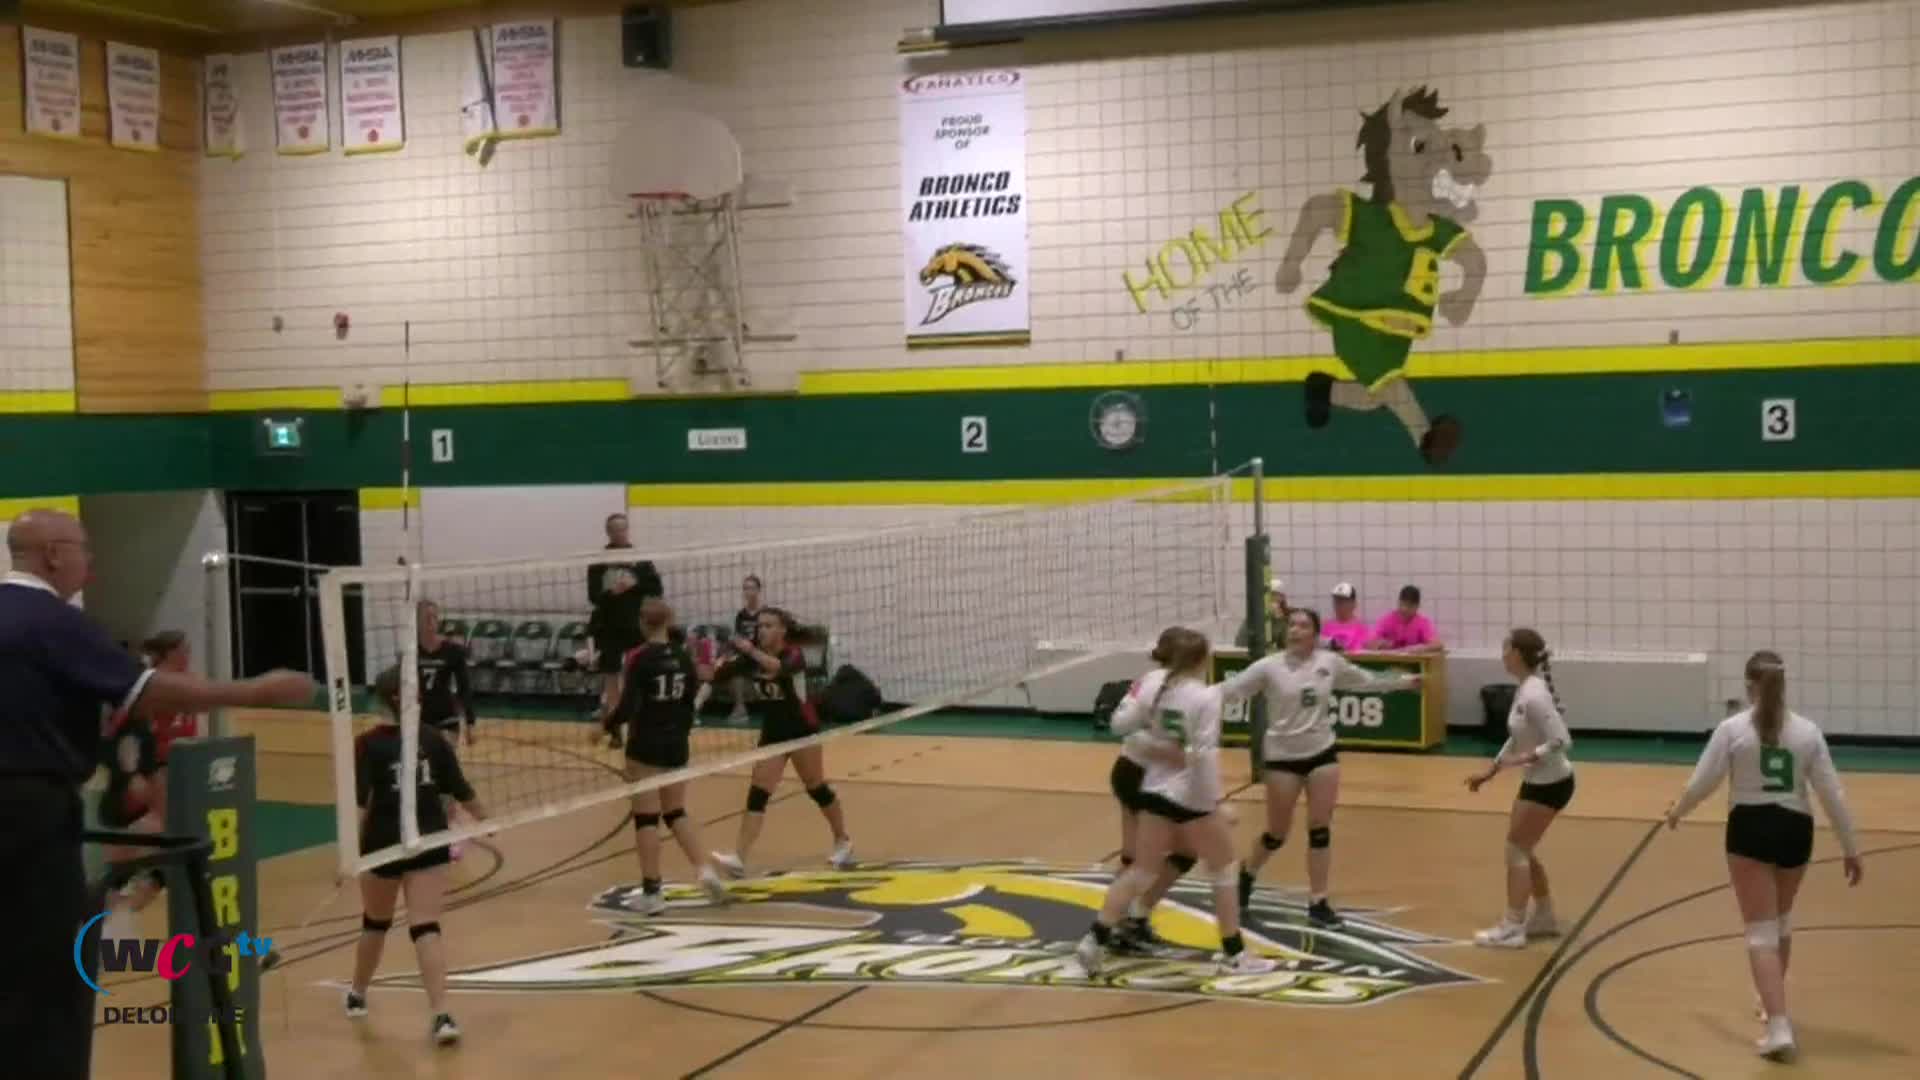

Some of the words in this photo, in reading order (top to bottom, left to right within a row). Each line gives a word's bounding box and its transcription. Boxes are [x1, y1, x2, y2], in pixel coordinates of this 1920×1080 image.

[934, 126, 990, 140] SPONSOR
[941, 114, 983, 127] PROUD
[954, 139, 971, 150] OF
[919, 170, 1011, 197] BRONCO
[908, 194, 1022, 222] ATHLETICS
[1122, 191, 1275, 314] HOME
[920, 280, 1017, 325] BRONCOS
[1171, 297, 1201, 330] OF
[1203, 267, 1257, 312] THE
[1766, 404, 1790, 436] 3
[439, 434, 450, 458] 1
[965, 420, 983, 449] 2
[655, 673, 687, 700] 15
[1760, 744, 1794, 792] 9
